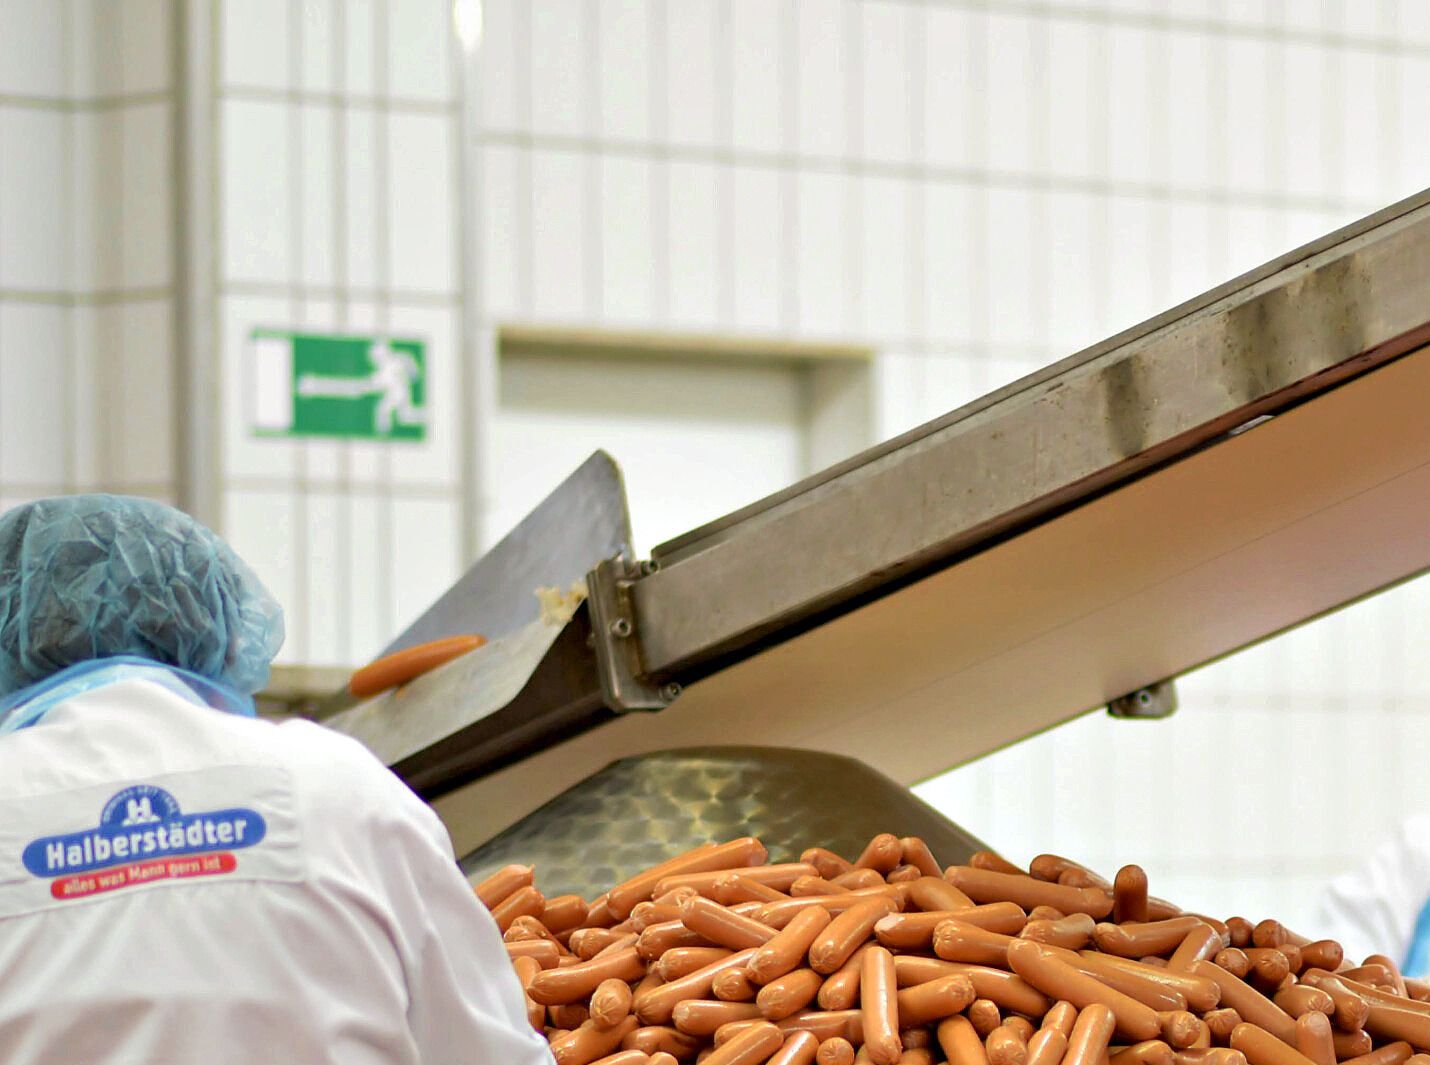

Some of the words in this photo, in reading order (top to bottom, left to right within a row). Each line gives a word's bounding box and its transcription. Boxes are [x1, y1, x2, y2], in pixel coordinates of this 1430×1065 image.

[46, 817, 248, 870] Halberstädter
[62, 877, 97, 895] alles
[99, 871, 126, 887] was
[128, 863, 166, 880] Mann
[168, 859, 201, 877] gern
